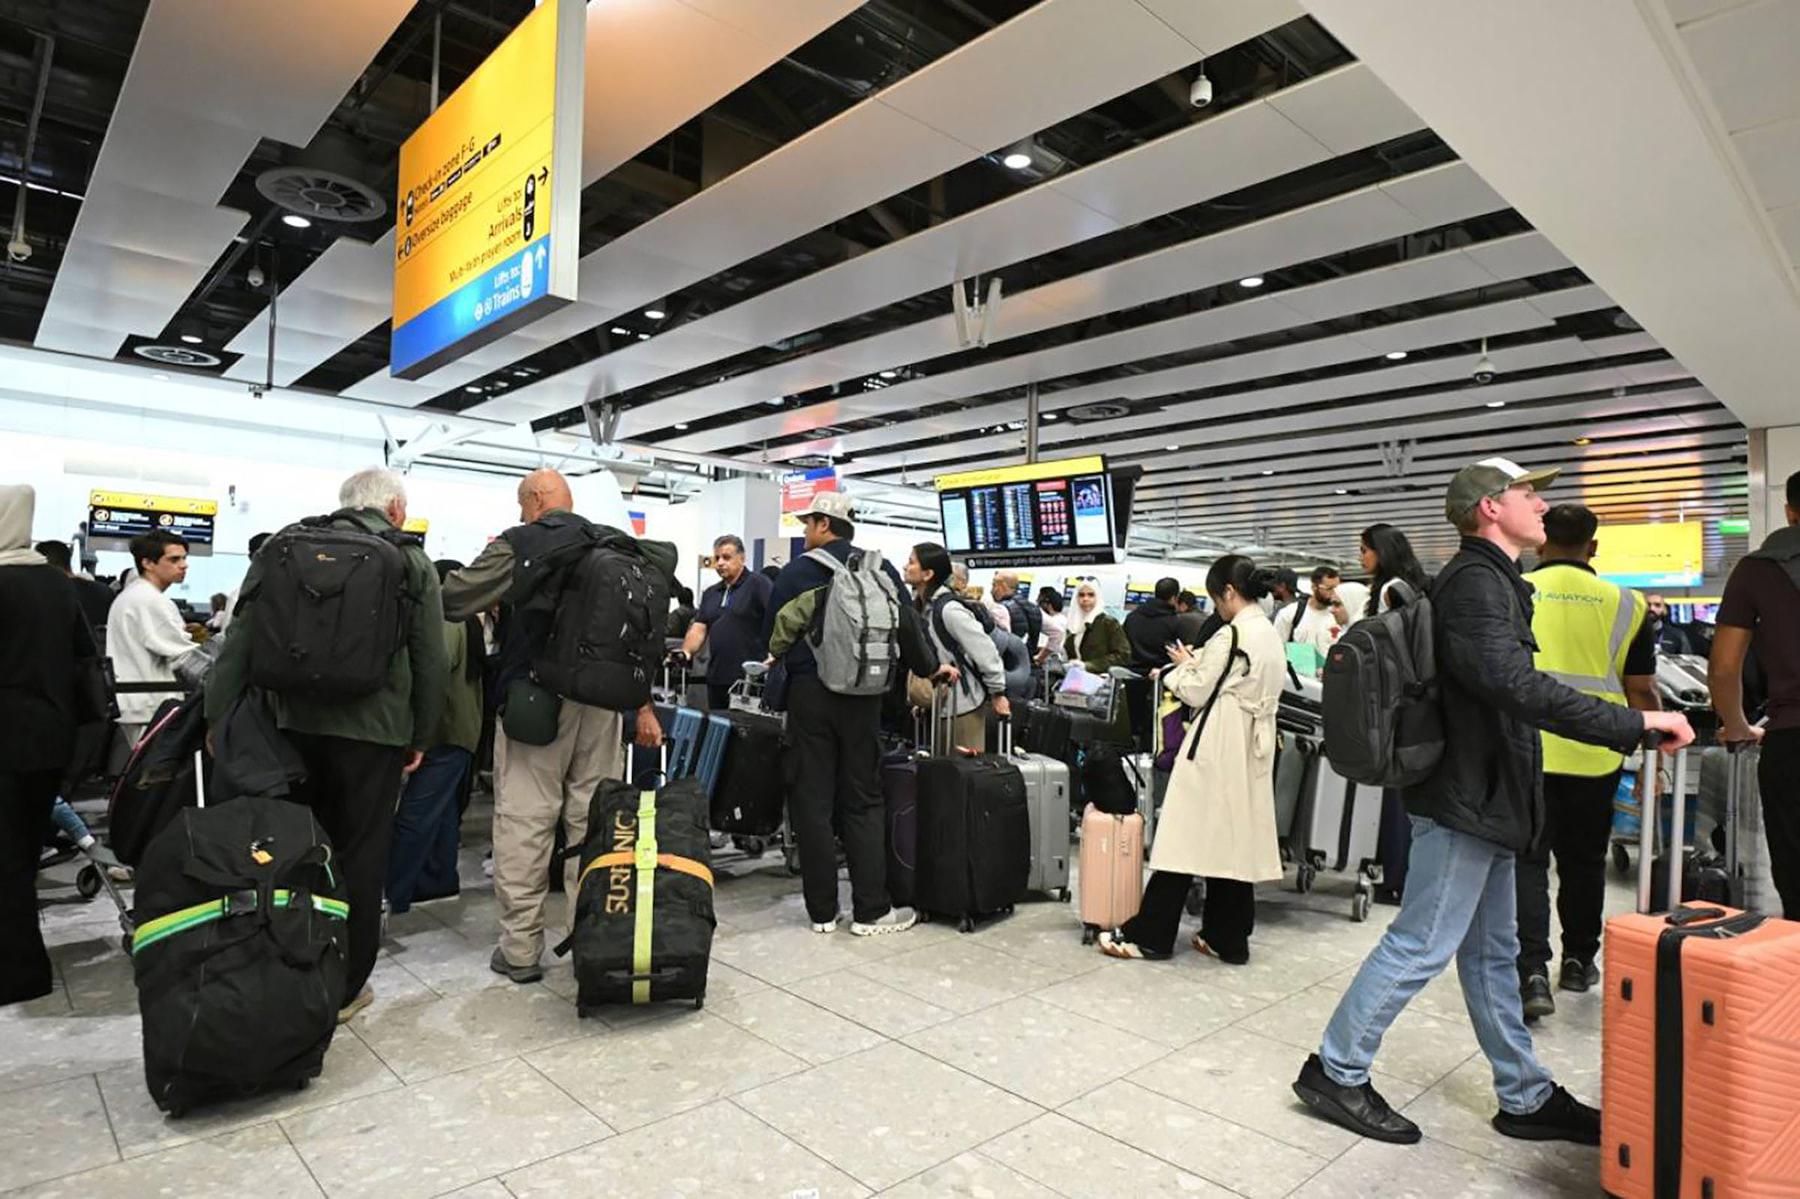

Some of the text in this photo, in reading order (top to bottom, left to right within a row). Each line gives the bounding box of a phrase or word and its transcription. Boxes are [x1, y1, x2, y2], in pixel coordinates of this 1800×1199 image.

[440, 191, 473, 226] baggage
[489, 205, 523, 240] Arrivals
[493, 284, 522, 310] Trains
[1546, 592, 1604, 604] AVIATION
